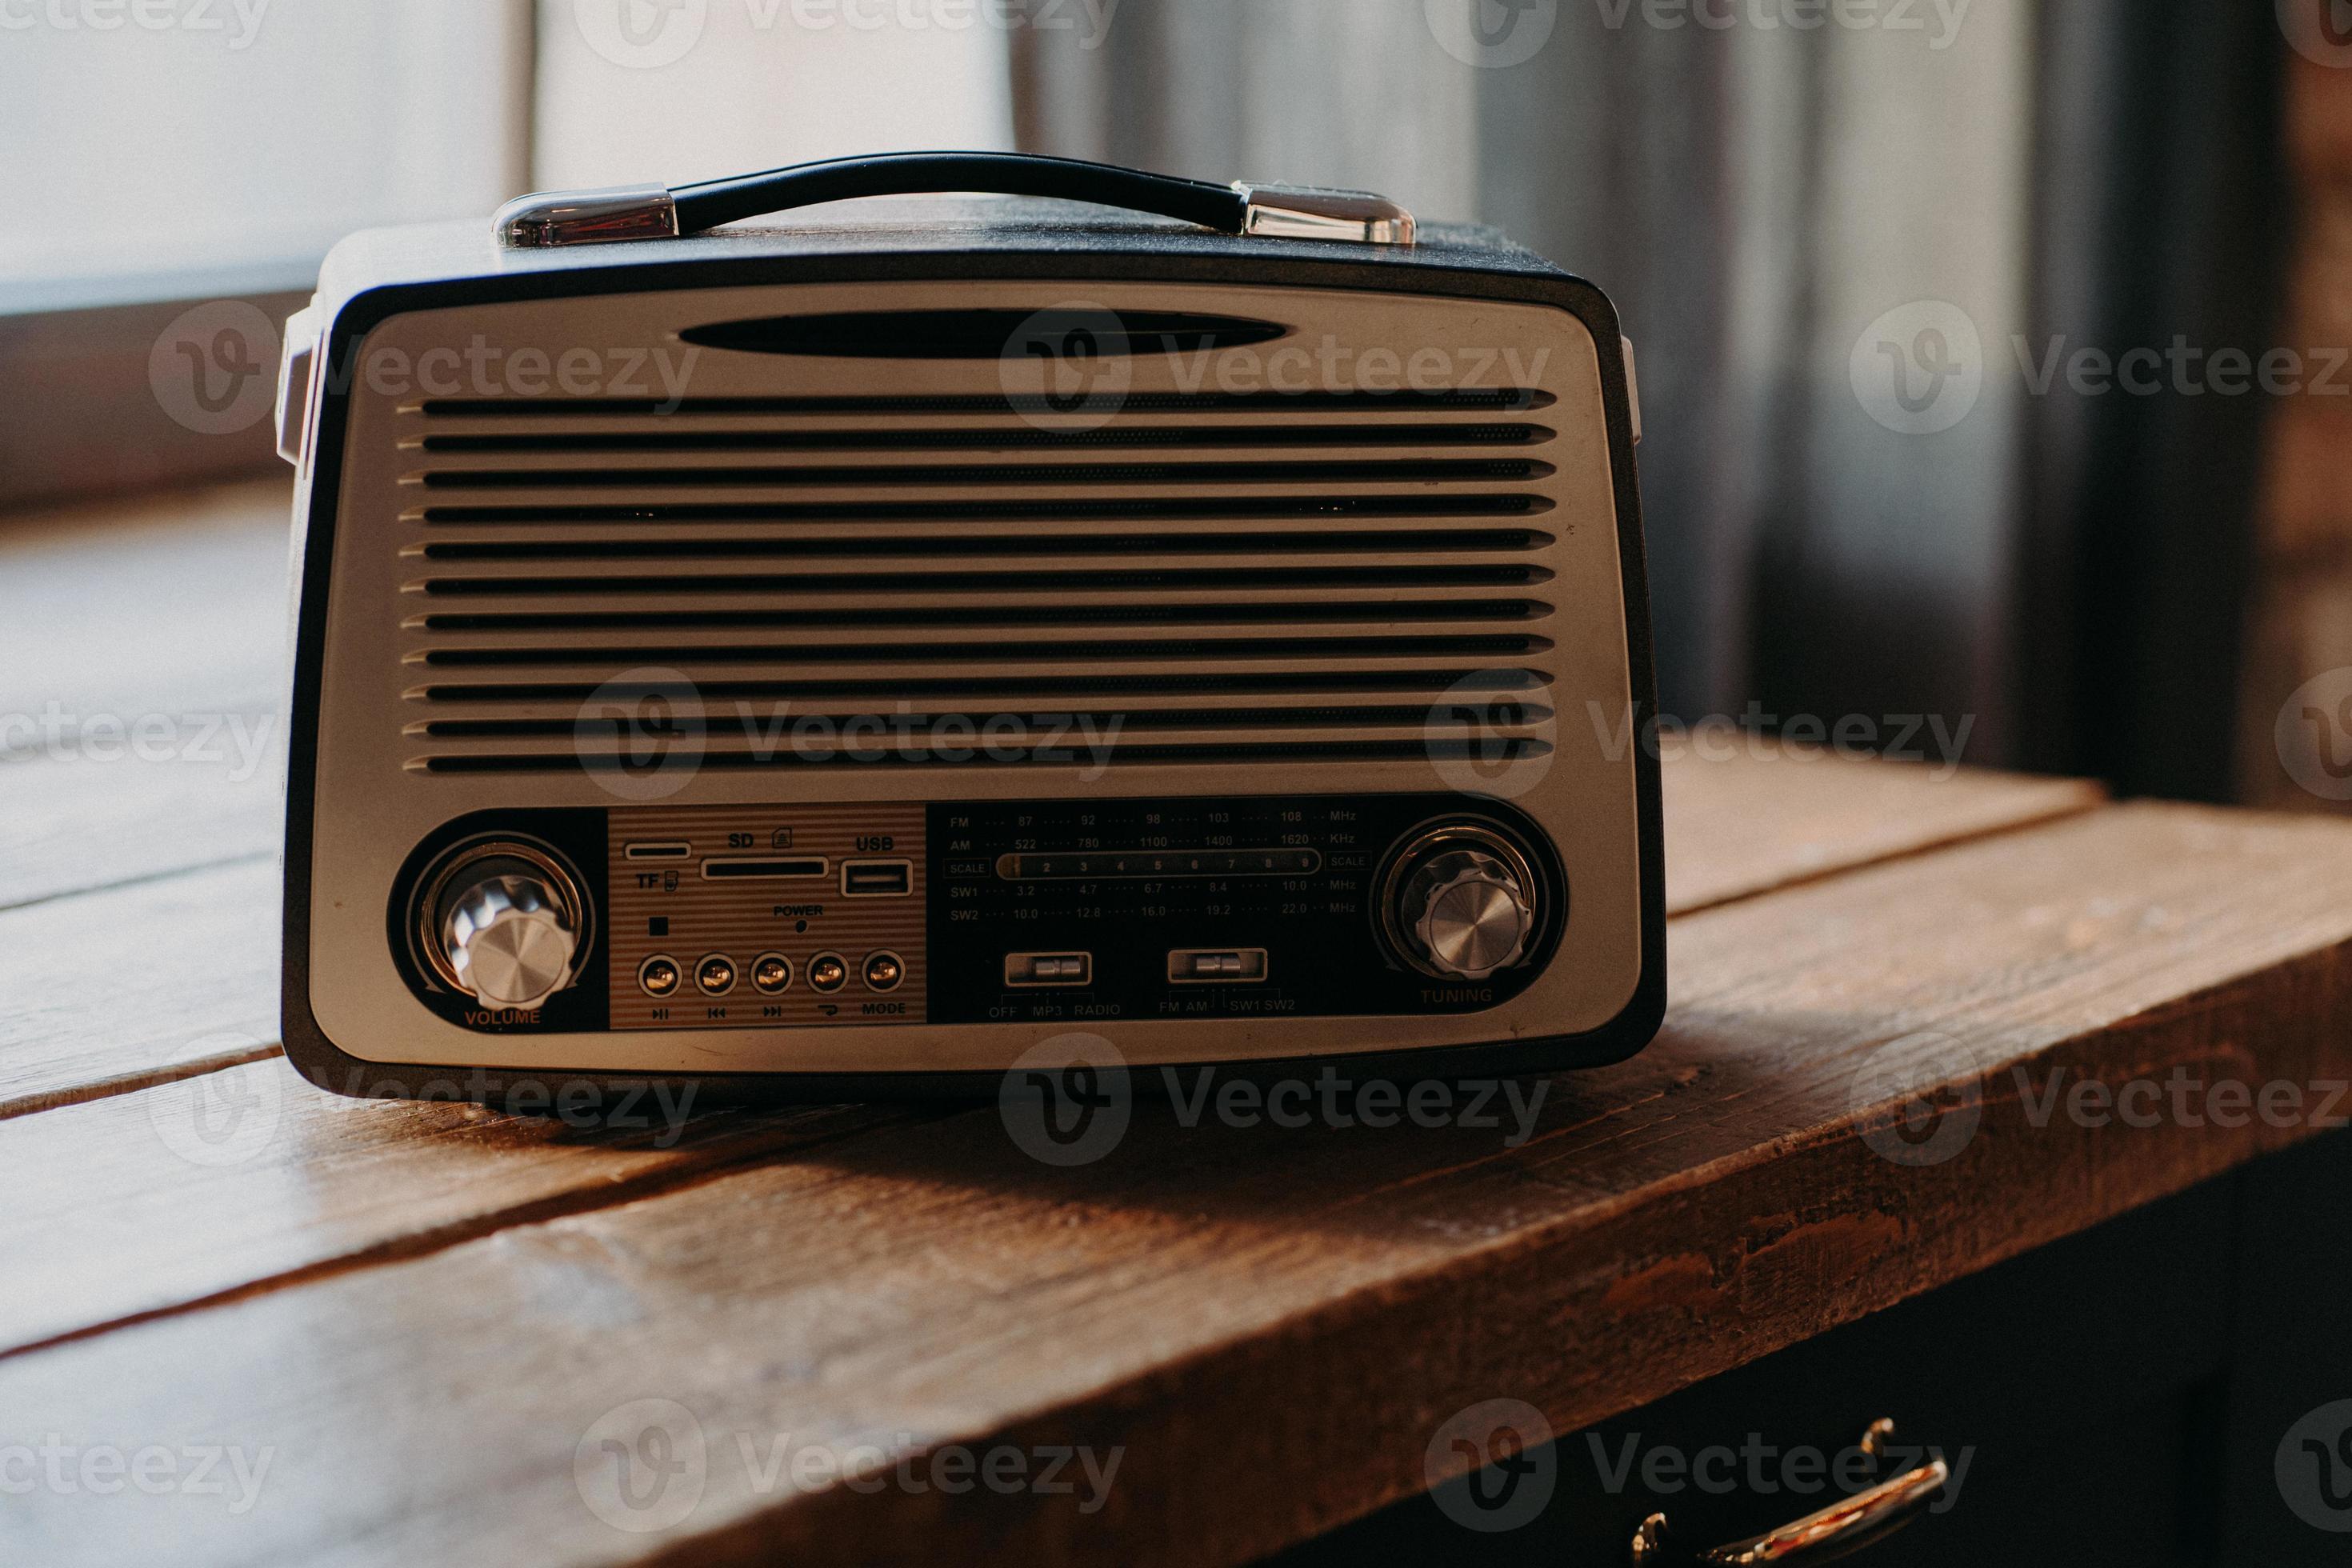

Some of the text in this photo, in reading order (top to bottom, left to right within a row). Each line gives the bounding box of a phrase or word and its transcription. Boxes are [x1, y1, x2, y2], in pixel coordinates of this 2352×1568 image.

[950, 810, 1357, 828] FM 87 92 98 103 108 MHz
[729, 833, 754, 849] SD
[856, 837, 894, 852] USB
[950, 834, 1356, 850] AM 522 780 1100 1400 1620 KHz
[950, 863, 986, 874] SCALE
[1042, 863, 1050, 873] 2
[1081, 862, 1088, 872] 3
[1116, 861, 1125, 871] 4
[1302, 857, 1310, 868] 9
[1330, 857, 1366, 867] SCALE
[636, 873, 658, 889] TF
[950, 879, 1357, 898] SW1 3.2 4.7 6.7 8.4 10.0 MHz
[774, 905, 823, 917] POWER
[950, 902, 1357, 921] SW2 10.0 12.8 16.0 19.2 22.0 MHz
[1420, 988, 1492, 1004] TUNING
[862, 1003, 906, 1015] MODE
[989, 1004, 1121, 1018] OFF MP3 RADIO
[1159, 998, 1296, 1012] FM AM SW1 SW2
[464, 1010, 541, 1025] VOLUME
